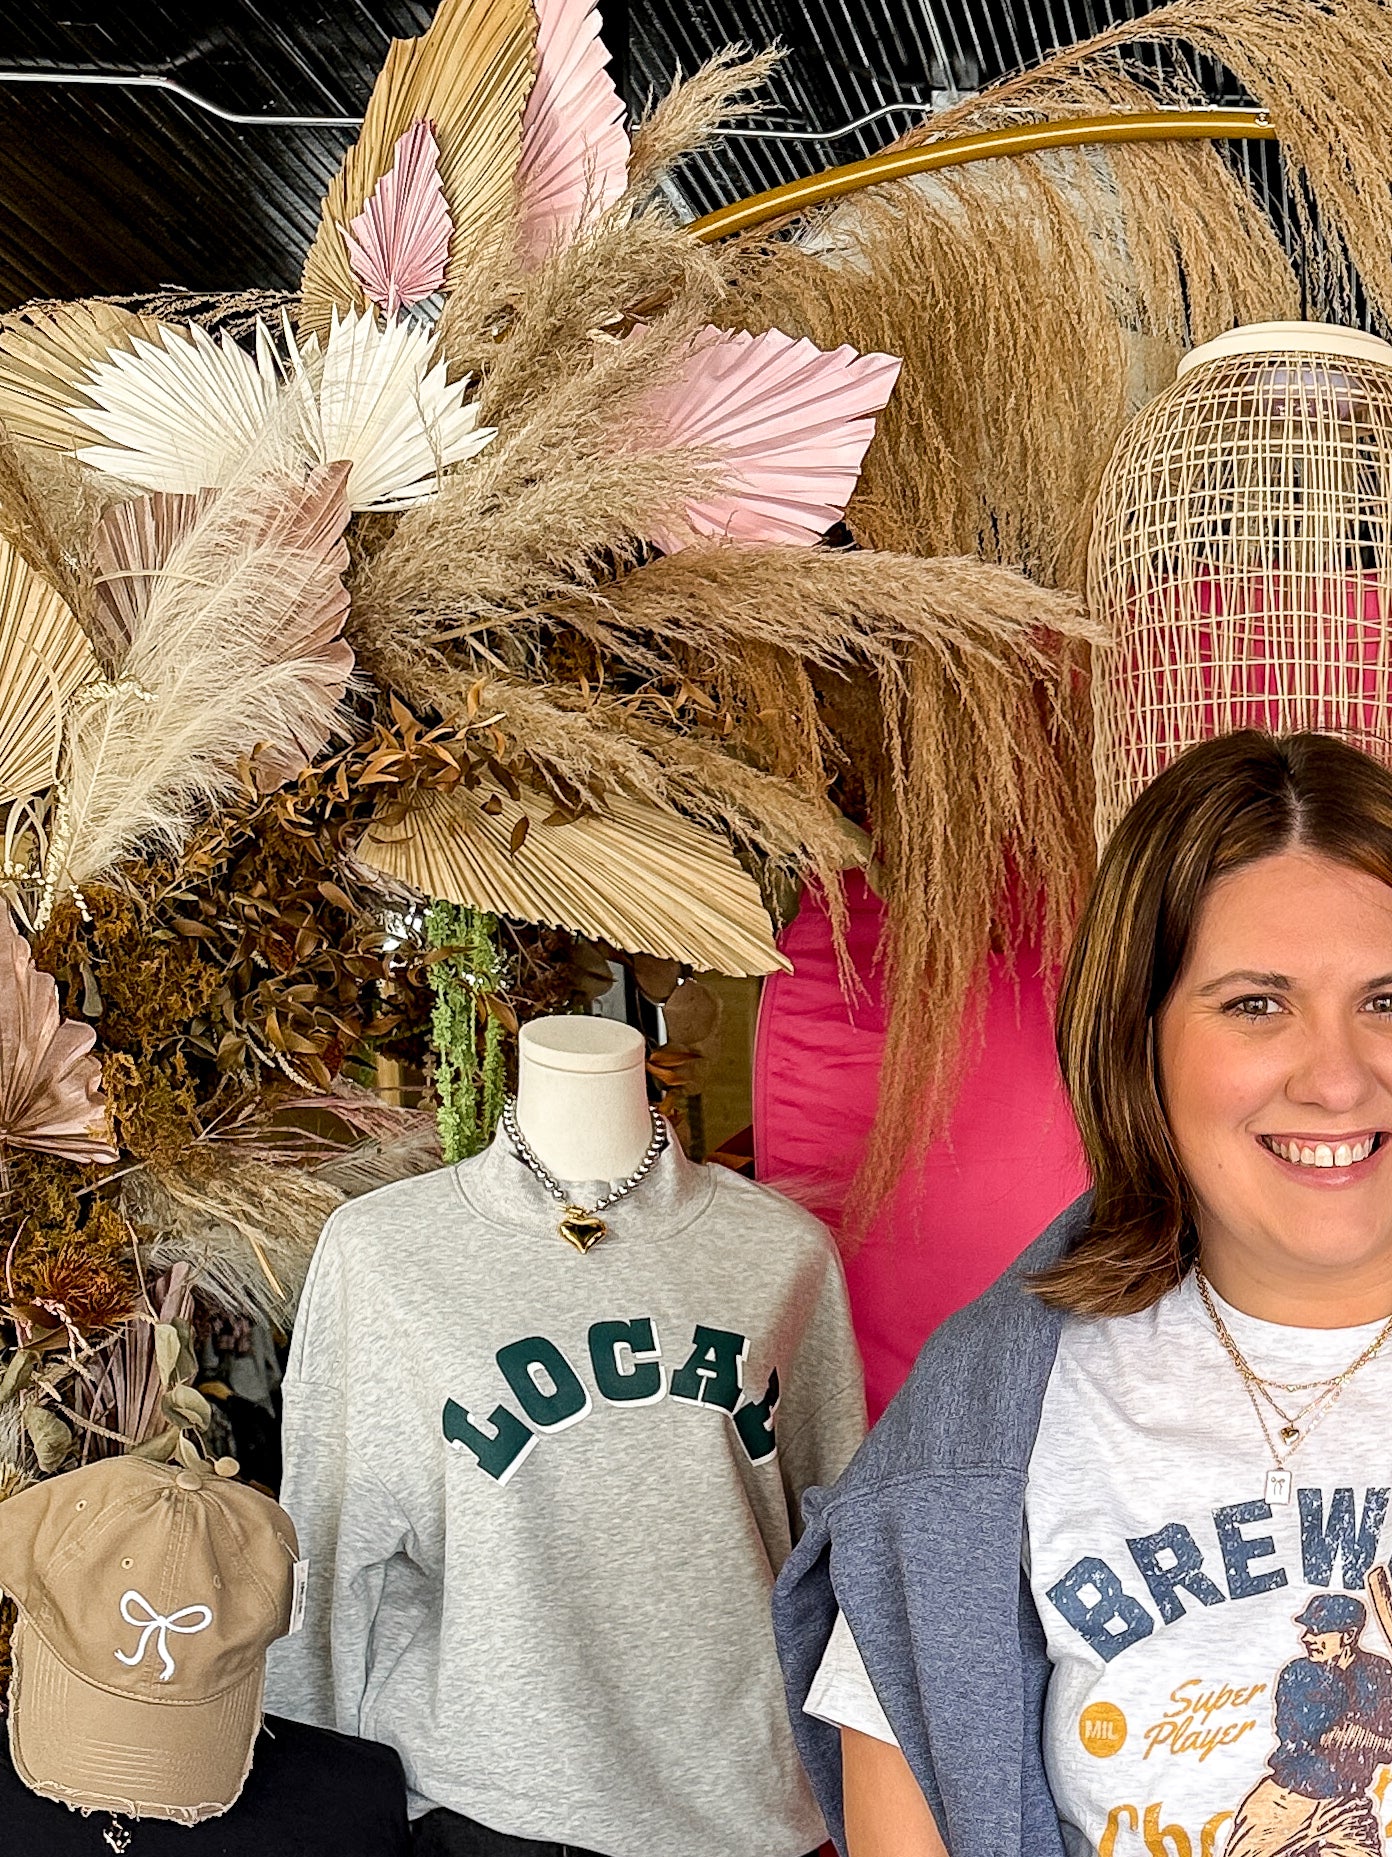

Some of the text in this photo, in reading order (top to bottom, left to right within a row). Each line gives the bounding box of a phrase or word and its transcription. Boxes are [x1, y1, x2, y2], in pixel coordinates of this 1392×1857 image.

[1163, 1679, 1267, 1725] Super
[1085, 1719, 1119, 1740] MIL
[1142, 1715, 1257, 1763] Player
